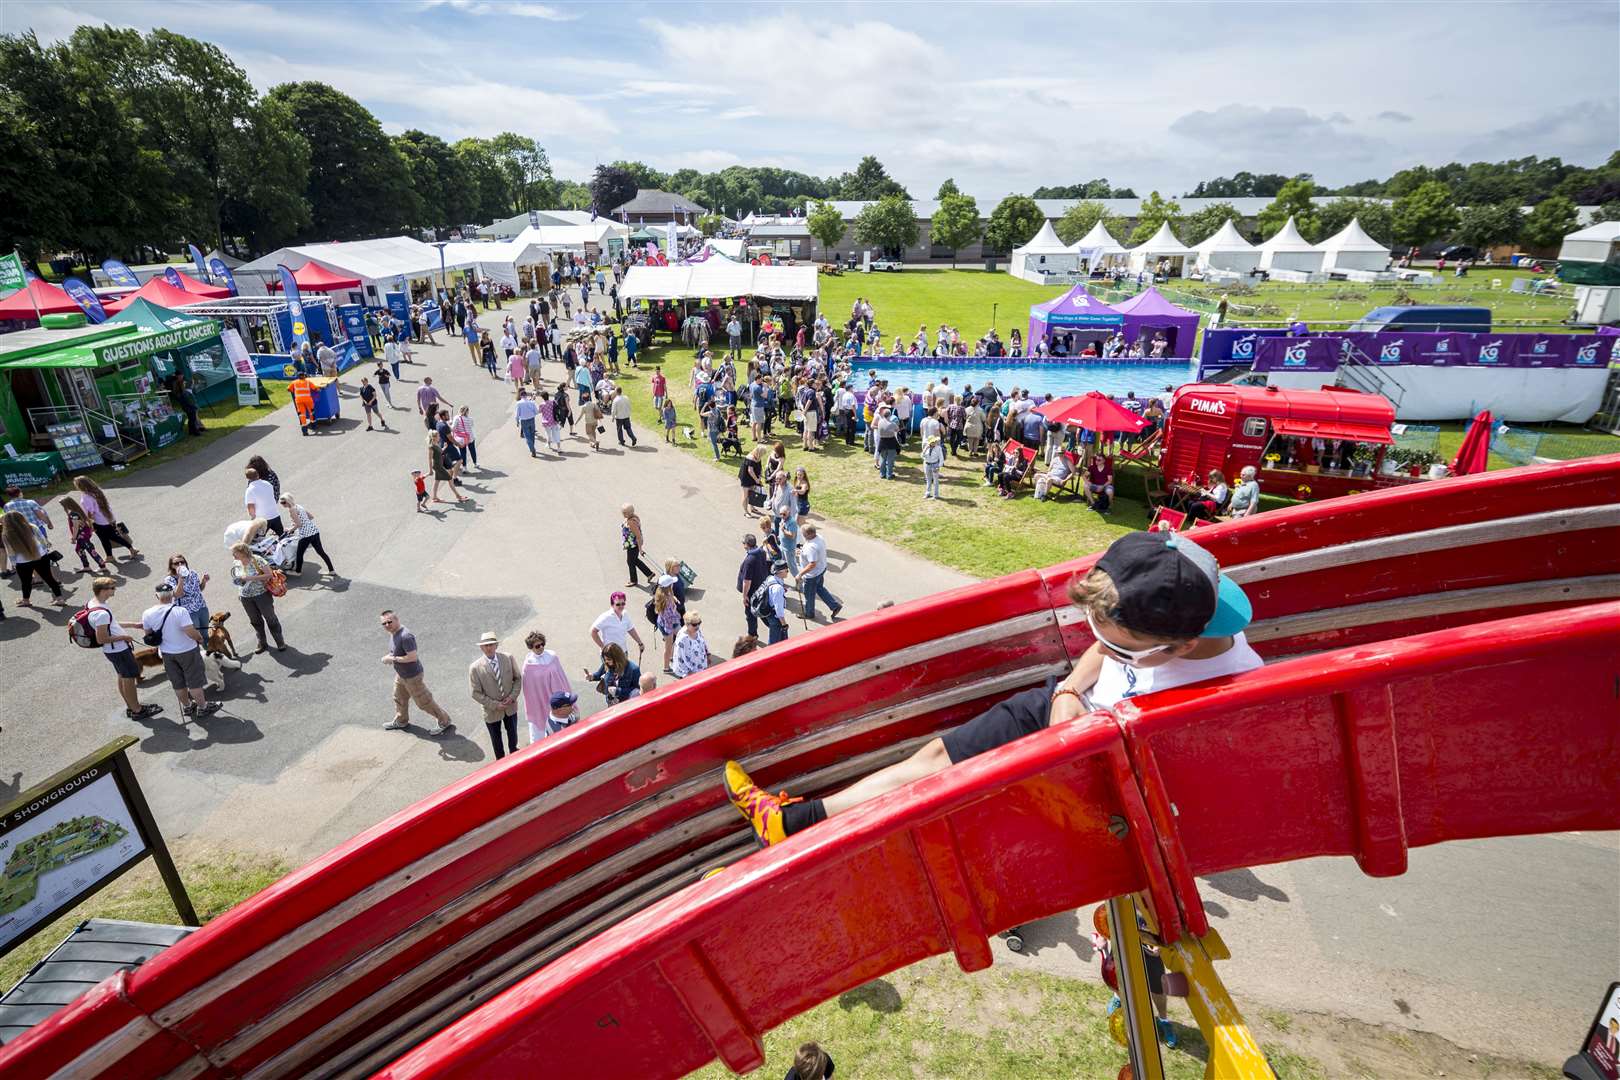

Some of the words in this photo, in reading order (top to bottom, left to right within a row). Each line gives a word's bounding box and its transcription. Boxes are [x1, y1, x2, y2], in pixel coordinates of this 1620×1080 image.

[102, 338, 155, 362] QUESTIONS
[155, 332, 182, 348] ABOUT
[183, 323, 216, 341] CANCER?
[1232, 340, 1253, 355] K9
[1285, 346, 1307, 363] K9
[1380, 345, 1401, 359] K9
[1479, 345, 1499, 360] K9
[1577, 347, 1597, 361] K9
[1190, 398, 1226, 415] PIMM'S
[0, 820, 7, 828] Y
[14, 768, 98, 821] SHOWGROUND
